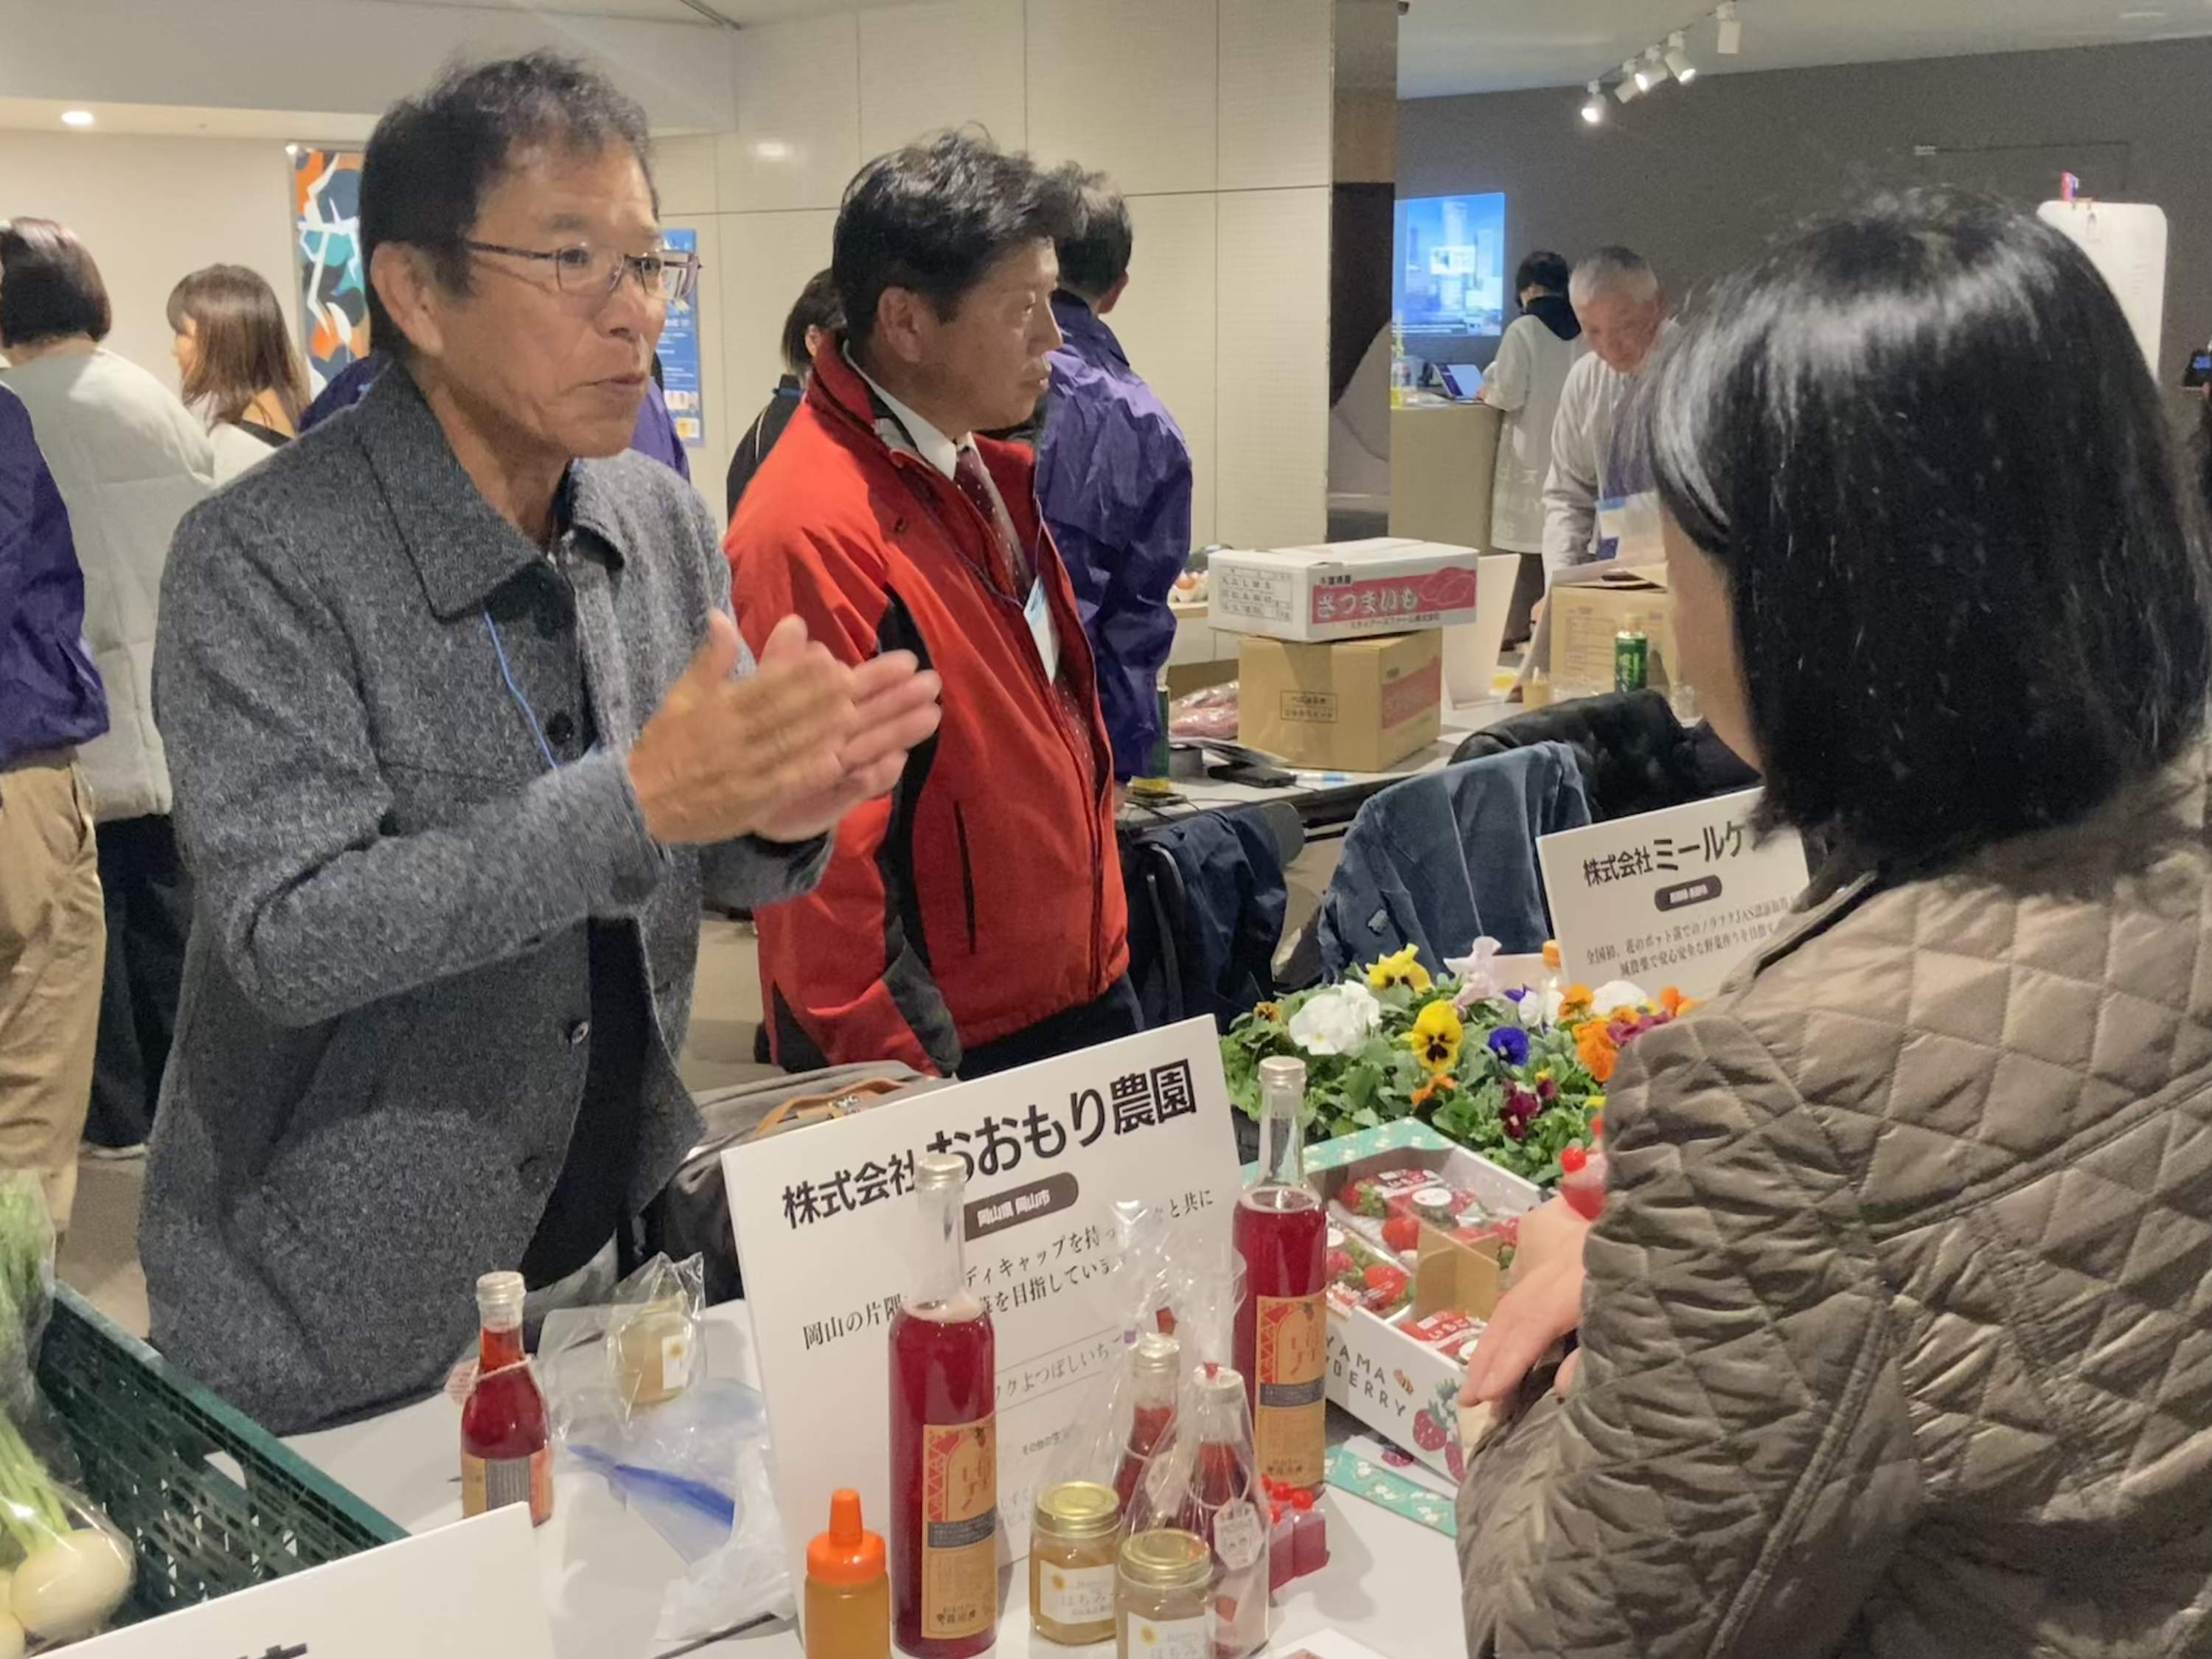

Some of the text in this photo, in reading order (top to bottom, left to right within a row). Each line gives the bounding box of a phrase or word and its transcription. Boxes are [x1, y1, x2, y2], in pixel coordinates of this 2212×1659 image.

[1317, 587, 1419, 619] さつまいも
[1583, 819, 1746, 887] 株式会社ミールケ
[782, 1059, 1198, 1230] 株式会社おおもり農園
[1326, 1355, 1406, 1417] BERRY
